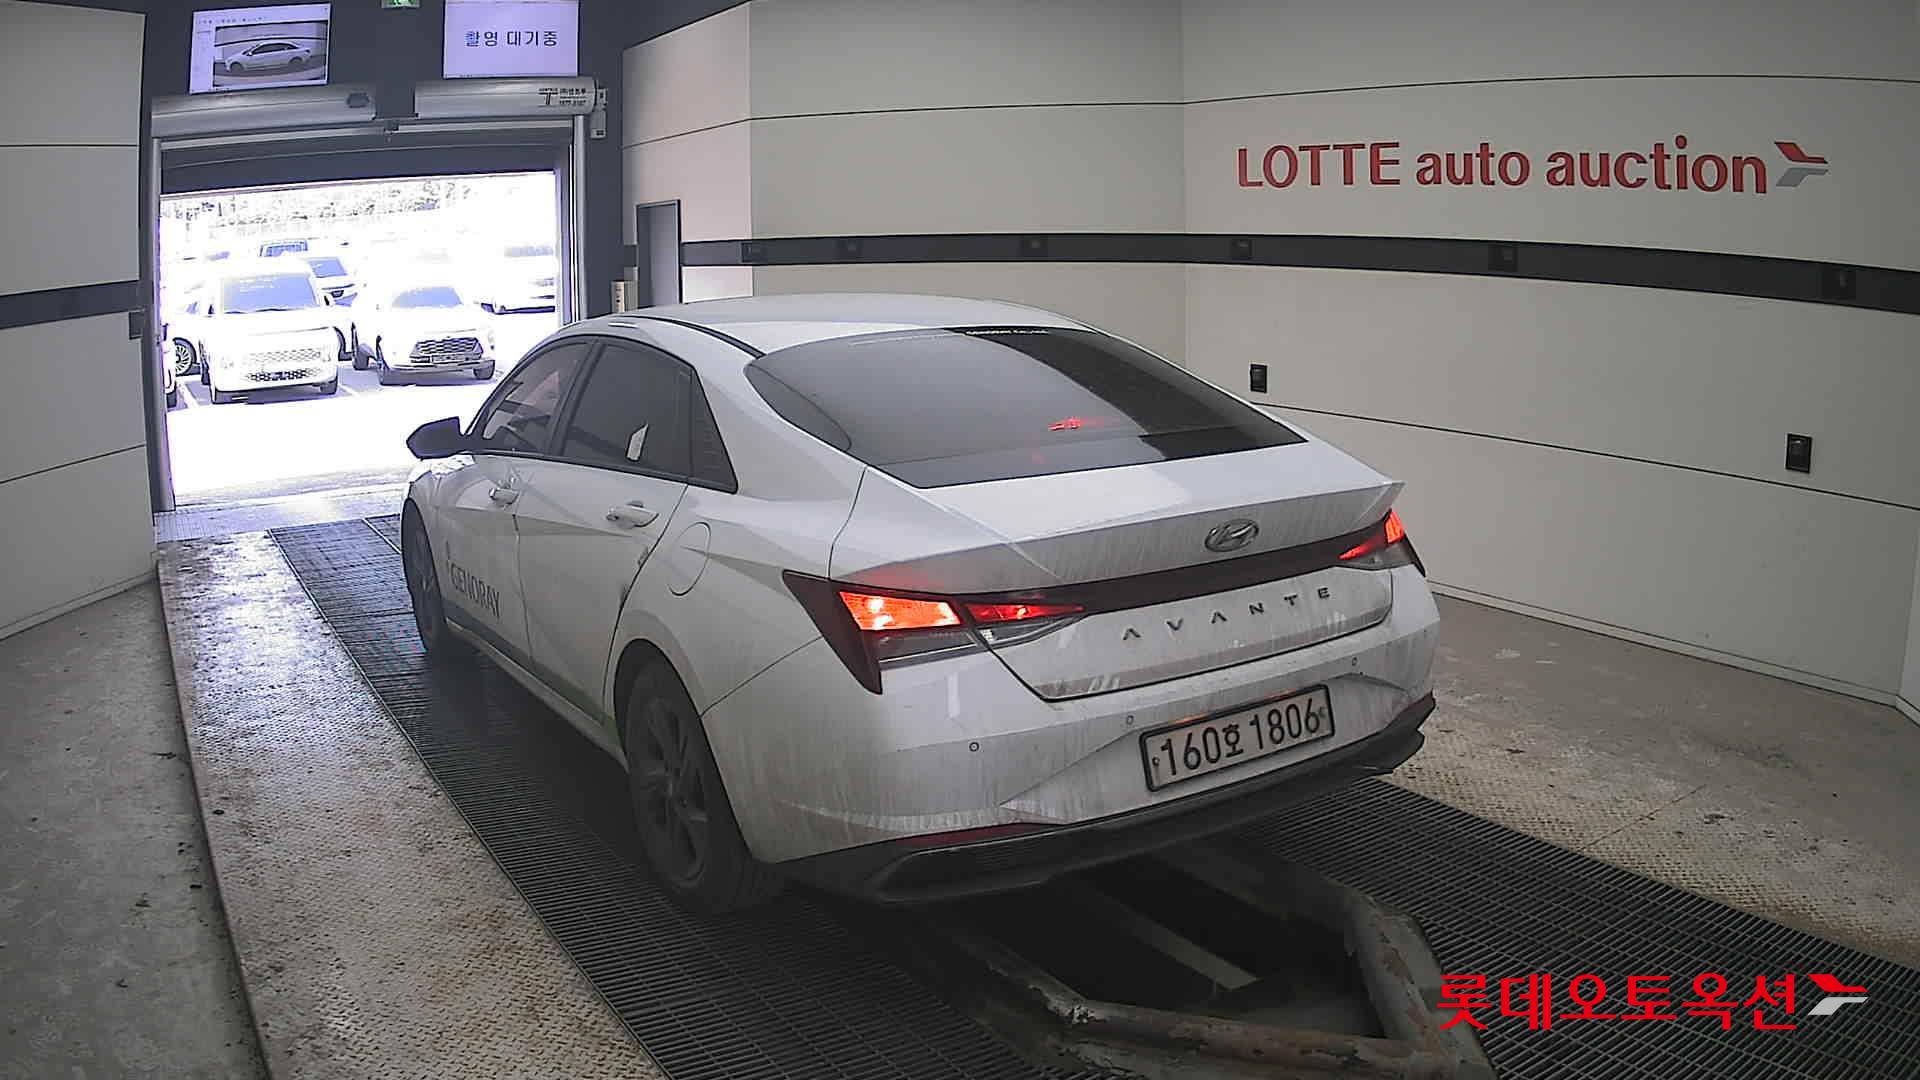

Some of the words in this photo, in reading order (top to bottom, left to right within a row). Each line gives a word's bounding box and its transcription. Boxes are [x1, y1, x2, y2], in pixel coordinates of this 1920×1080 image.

[1237, 142, 1400, 188] LOTTE
[1415, 142, 1531, 187] auto
[1546, 135, 1767, 194] auction
[451, 562, 500, 618] GENORAY
[1122, 587, 1331, 641] AVANTE
[1160, 723, 1245, 776] 160호
[1249, 697, 1321, 750] 1806
